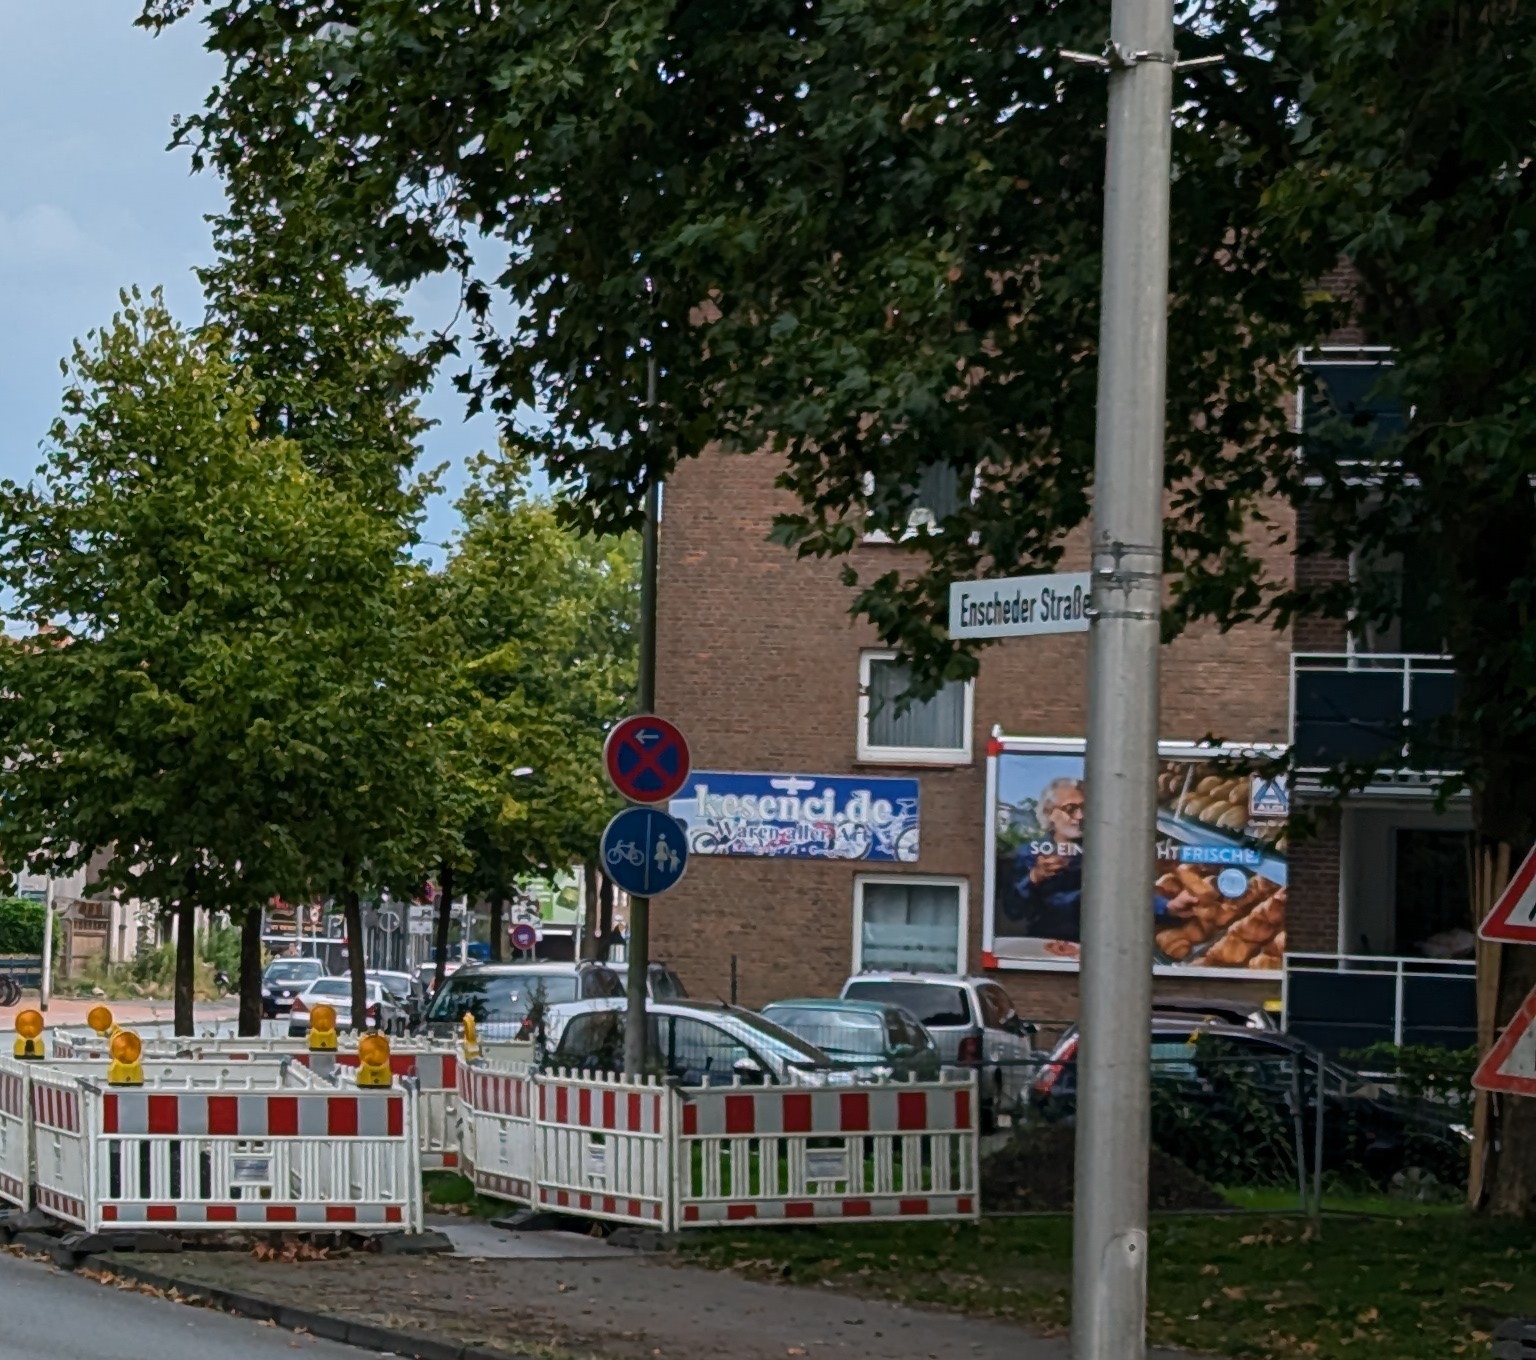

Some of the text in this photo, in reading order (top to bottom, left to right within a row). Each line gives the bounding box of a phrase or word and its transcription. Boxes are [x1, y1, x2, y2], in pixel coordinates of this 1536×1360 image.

[960, 584, 1091, 628] Enscheder Straße
[694, 783, 894, 824] kesenci.de
[714, 820, 779, 842] Waren
[1029, 840, 1055, 856] SO
